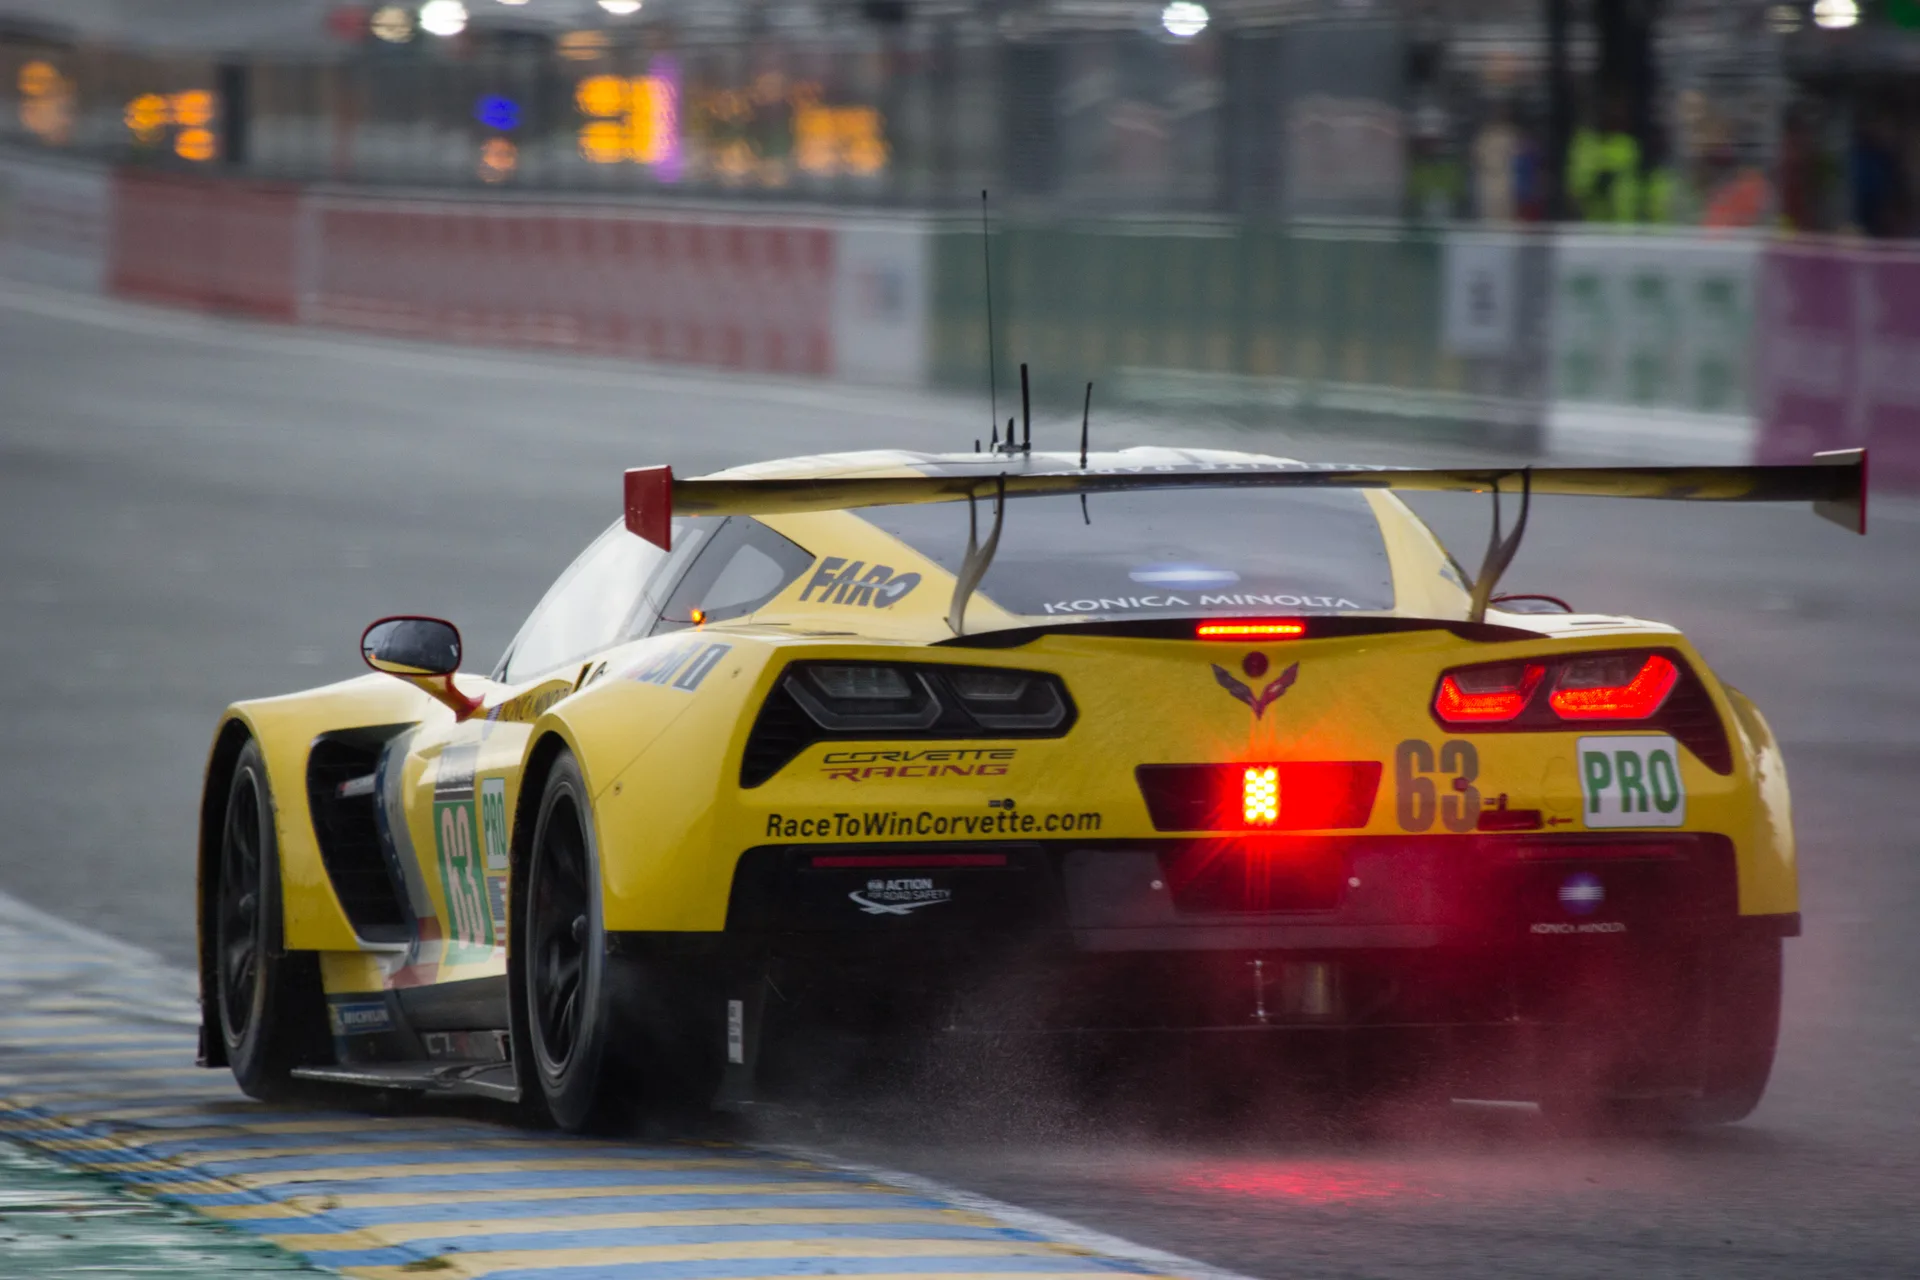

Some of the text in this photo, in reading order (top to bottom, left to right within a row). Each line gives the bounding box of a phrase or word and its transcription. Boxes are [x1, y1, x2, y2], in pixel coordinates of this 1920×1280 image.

[799, 557, 922, 608] FARO
[1044, 594, 1360, 614] KONICA MINOLTA
[823, 748, 1018, 764] CORVETTE
[820, 764, 1009, 781] RACING
[1584, 749, 1681, 813] PRO
[1395, 739, 1481, 833] 63
[766, 810, 1102, 838] RaceToWinCorvette.com
[886, 879, 933, 890] ACTION
[913, 889, 952, 899] SAFETY
